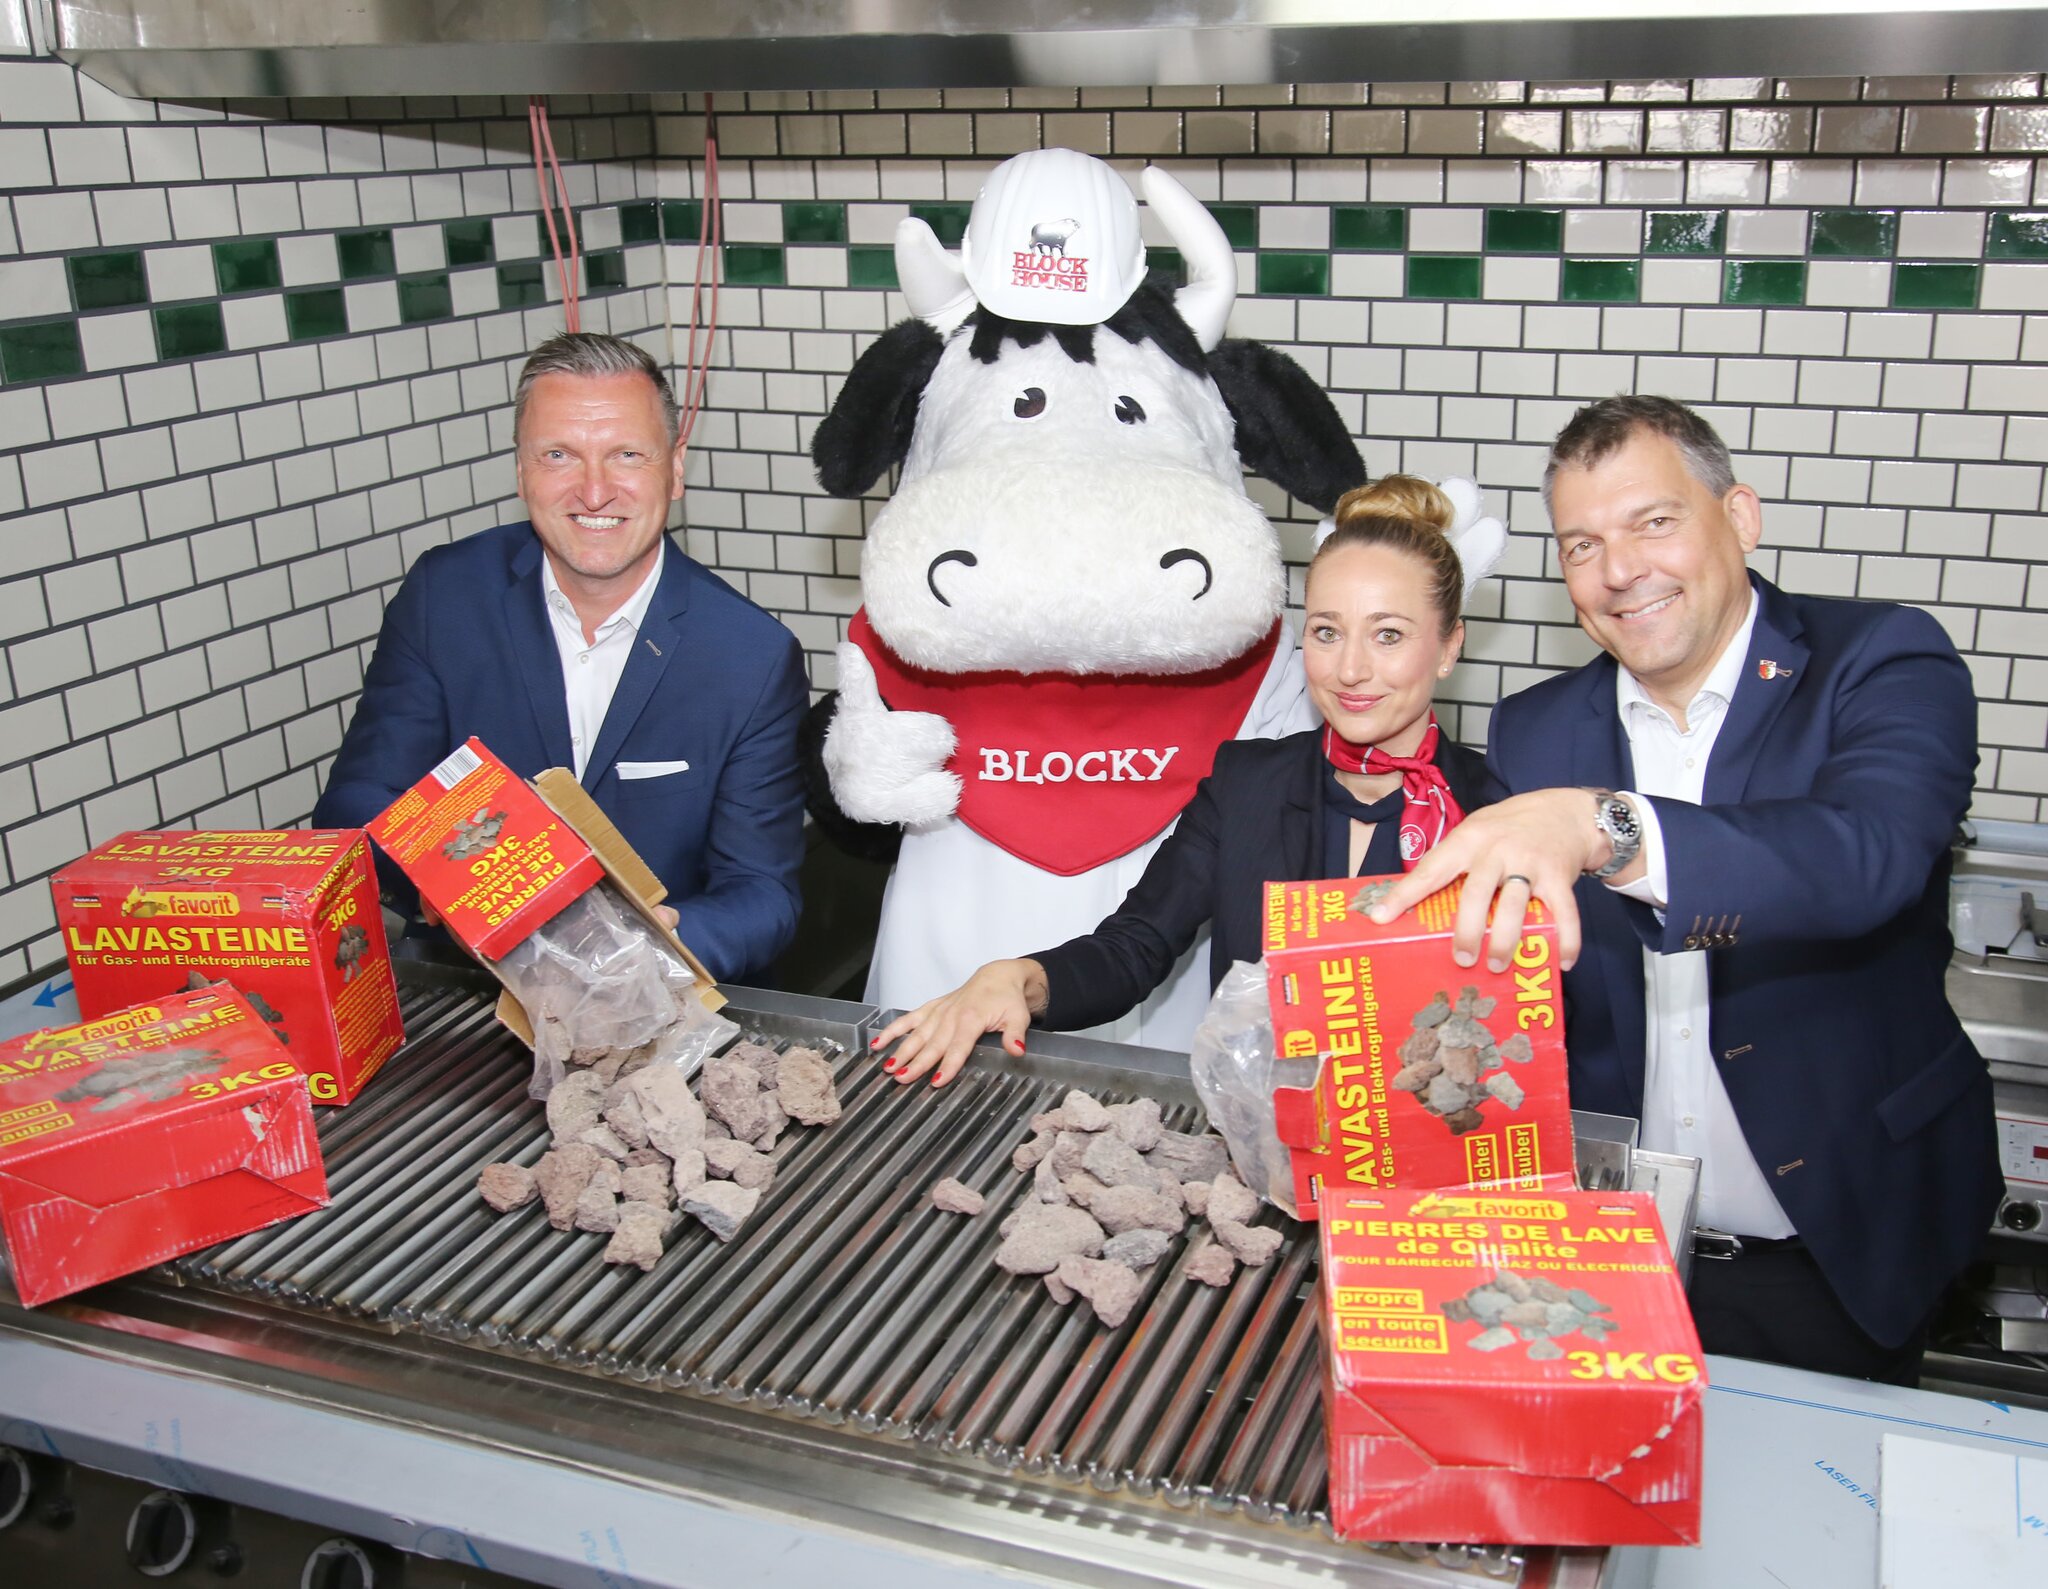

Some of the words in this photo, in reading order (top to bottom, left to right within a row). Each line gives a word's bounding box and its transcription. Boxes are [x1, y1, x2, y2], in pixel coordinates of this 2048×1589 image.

[1012, 251, 1090, 275] BLOCK
[1011, 269, 1088, 292] HOUSE
[978, 746, 1180, 785] BLOCKY
[107, 844, 340, 858] LAVASTEINE
[223, 833, 280, 843] favorit
[520, 840, 551, 864] POUR
[470, 835, 522, 877] 3KG
[510, 848, 526, 862] OU
[526, 850, 554, 873] DE
[158, 866, 235, 877] 3KG
[445, 861, 510, 914] ELECTRIQUE
[466, 863, 521, 909] BARBECUE
[477, 872, 526, 914] LAVE
[486, 861, 566, 926] PIERRES
[169, 895, 233, 915] favorit
[328, 897, 357, 932] 3KG
[1268, 883, 1286, 950] LAVASTEINE
[1322, 890, 1347, 923] 3KG
[68, 926, 309, 952] LAVASTEINE
[76, 954, 98, 965] für
[103, 954, 138, 966] Gas-
[142, 954, 171, 965] und
[175, 954, 311, 969] Elektrogrillgeräte
[1512, 934, 1555, 1030] 3KG
[80, 1010, 155, 1041] favorit
[1358, 955, 1387, 1105] Elektrogrillgeräte
[47, 1059, 82, 1072] und
[1319, 957, 1379, 1190] AVASTEINE
[188, 1061, 296, 1099] 3KG
[1374, 1109, 1391, 1139] und
[1380, 1142, 1396, 1178] Gas-
[1513, 1129, 1534, 1188] sauber
[1474, 1201, 1557, 1218] favorit
[1330, 1219, 1489, 1239] PIERRES
[1501, 1223, 1550, 1241] DE
[1560, 1226, 1657, 1243] LAVE
[1396, 1238, 1440, 1254] de
[1450, 1238, 1578, 1258] Qualite
[1333, 1255, 1381, 1266] POUR
[1385, 1257, 1476, 1268] BARBECUE
[1536, 1261, 1562, 1271] OU
[1566, 1261, 1674, 1274] ELECTRIQUE
[1339, 1292, 1418, 1307] propre
[1343, 1318, 1371, 1330] en
[1377, 1317, 1436, 1332] toute
[1344, 1335, 1437, 1349] securite
[1566, 1350, 1699, 1383] 3KG
[1813, 1459, 1861, 1494] LASER
